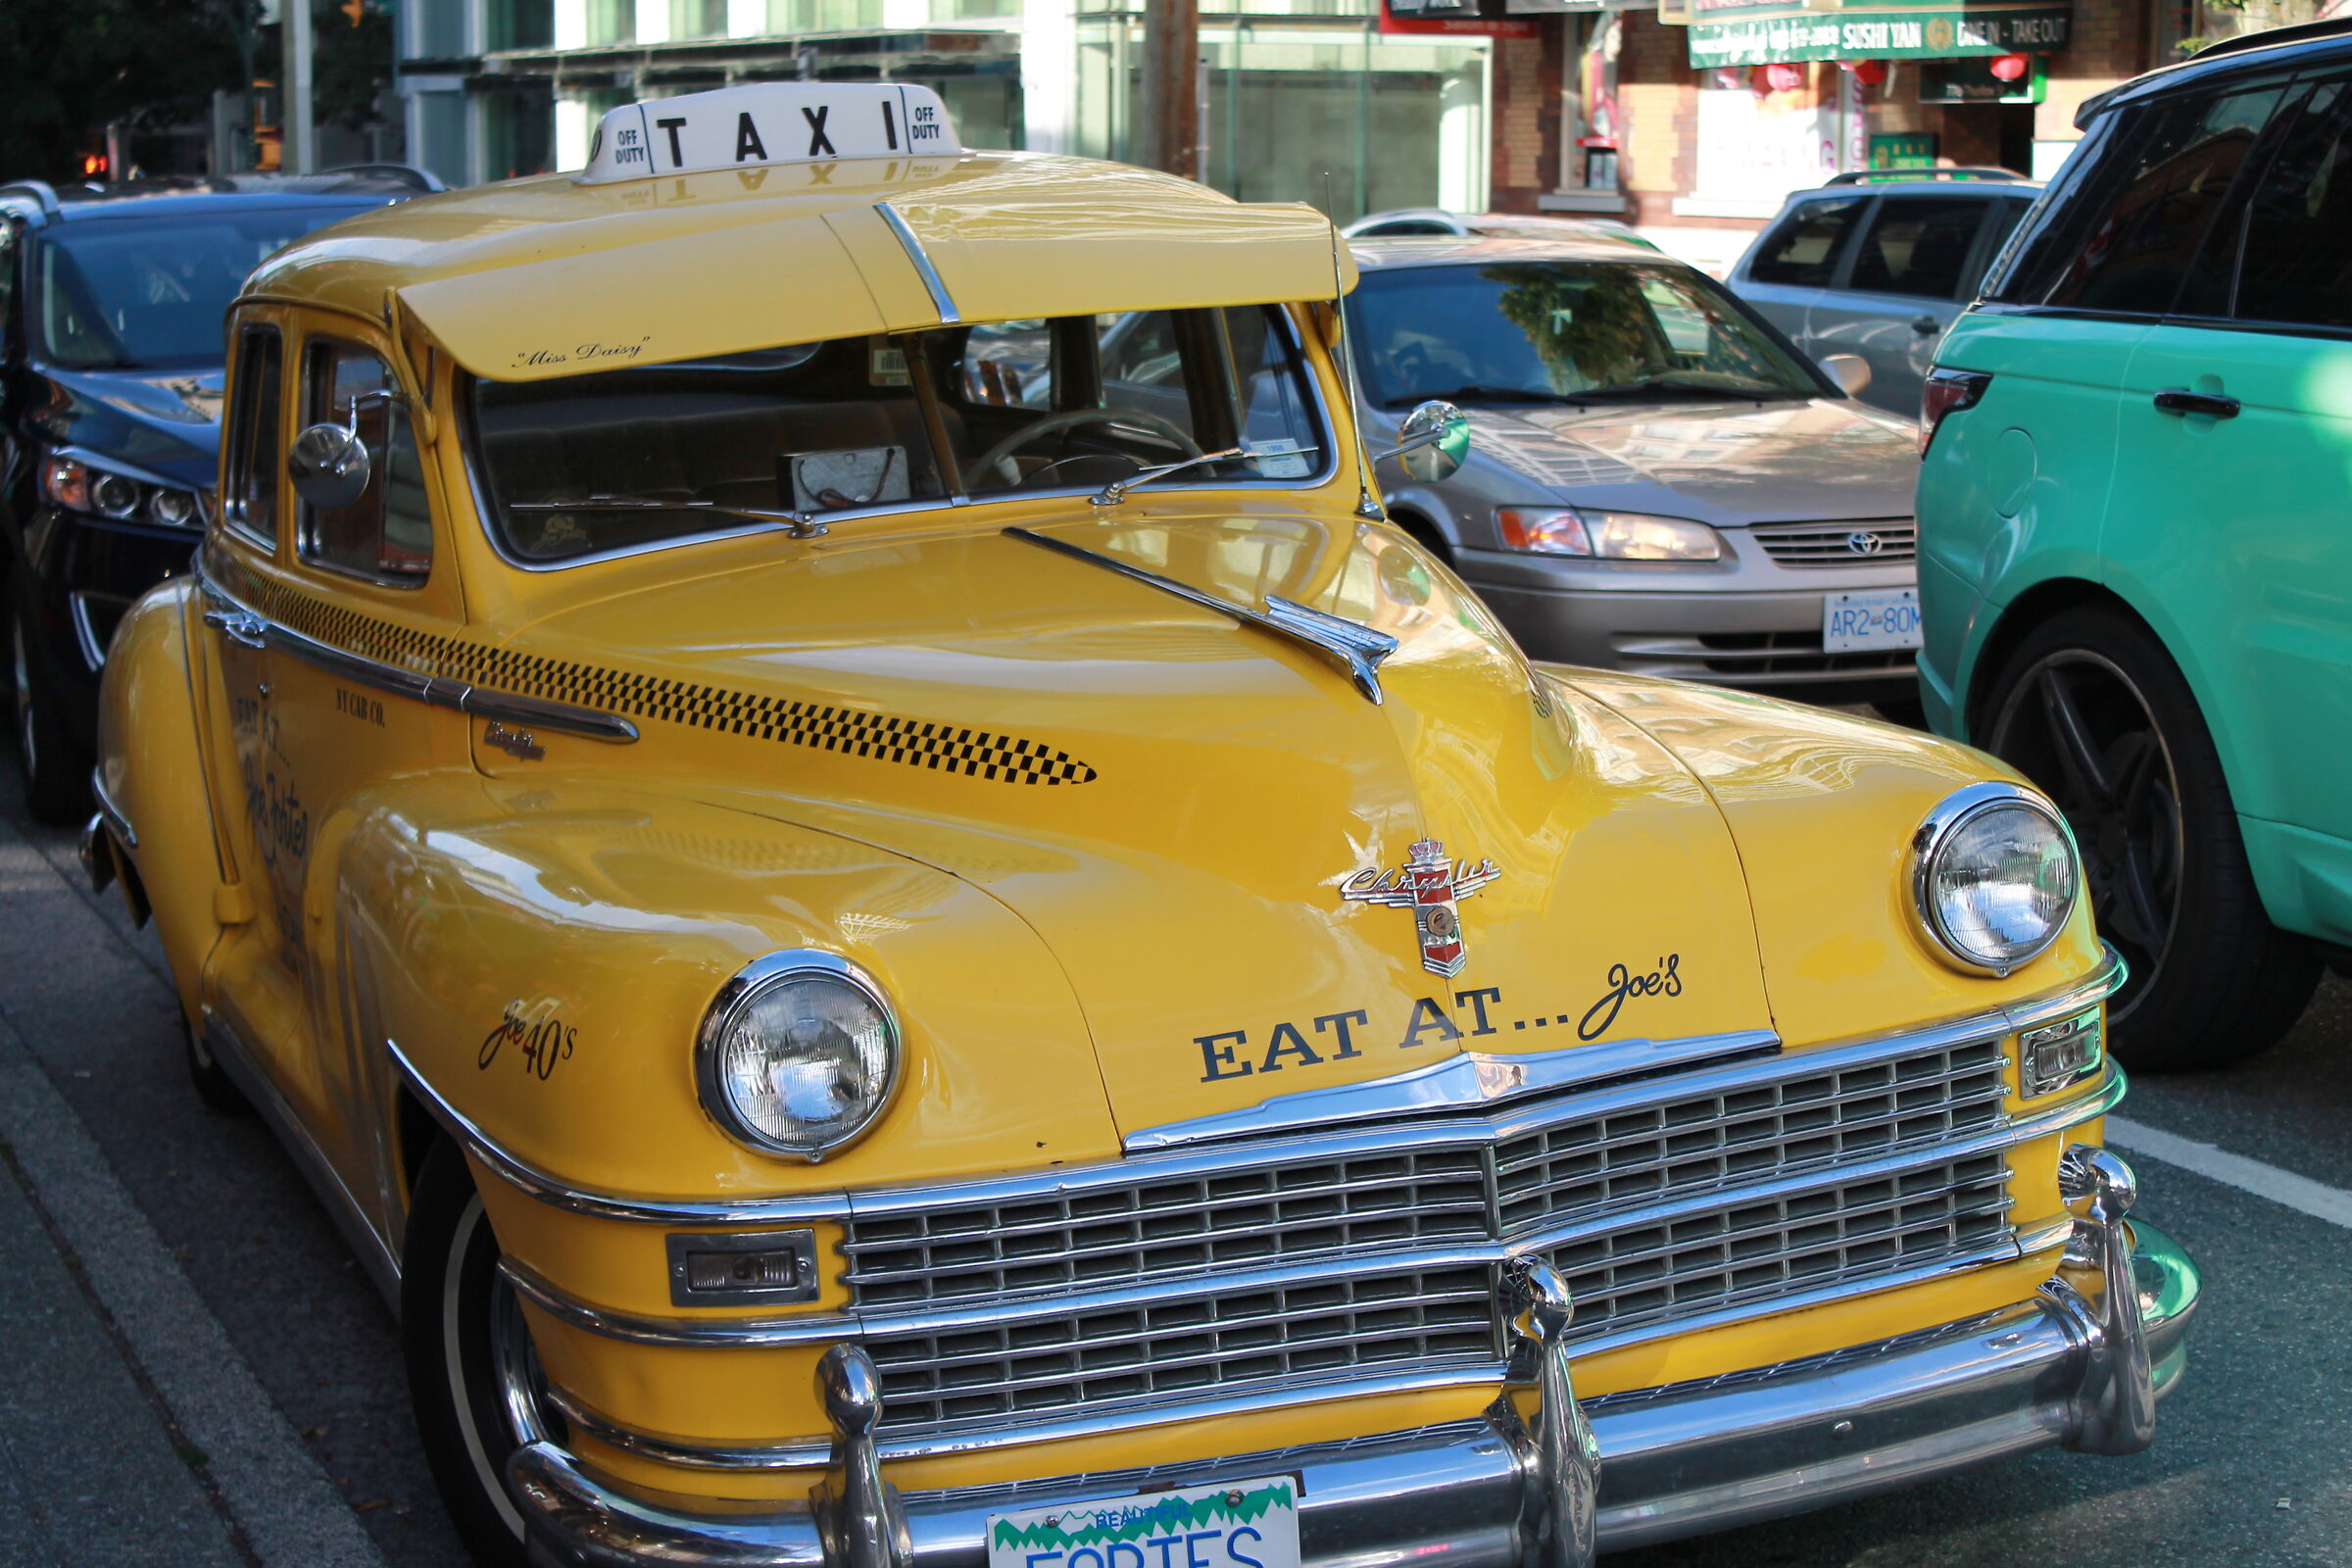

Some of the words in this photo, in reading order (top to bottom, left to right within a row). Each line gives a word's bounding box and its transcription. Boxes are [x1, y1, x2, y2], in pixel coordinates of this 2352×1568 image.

[1841, 22, 1888, 49] SUSHI
[1889, 22, 1922, 48] YAN
[2012, 19, 2038, 43] TAKE
[2040, 18, 2067, 42] OUT
[914, 106, 934, 122] OFF
[617, 129, 638, 146] OFF
[657, 101, 898, 168] TAXI
[912, 124, 941, 140] DUTY
[615, 147, 645, 165] DUTY
[335, 688, 348, 714] NY
[350, 692, 368, 720] CAB
[1341, 858, 1501, 900] Chrysler
[477, 998, 527, 1071] Joe
[1193, 1008, 1368, 1084] EAT
[1096, 1502, 1193, 1530] BEAUTIFUL
